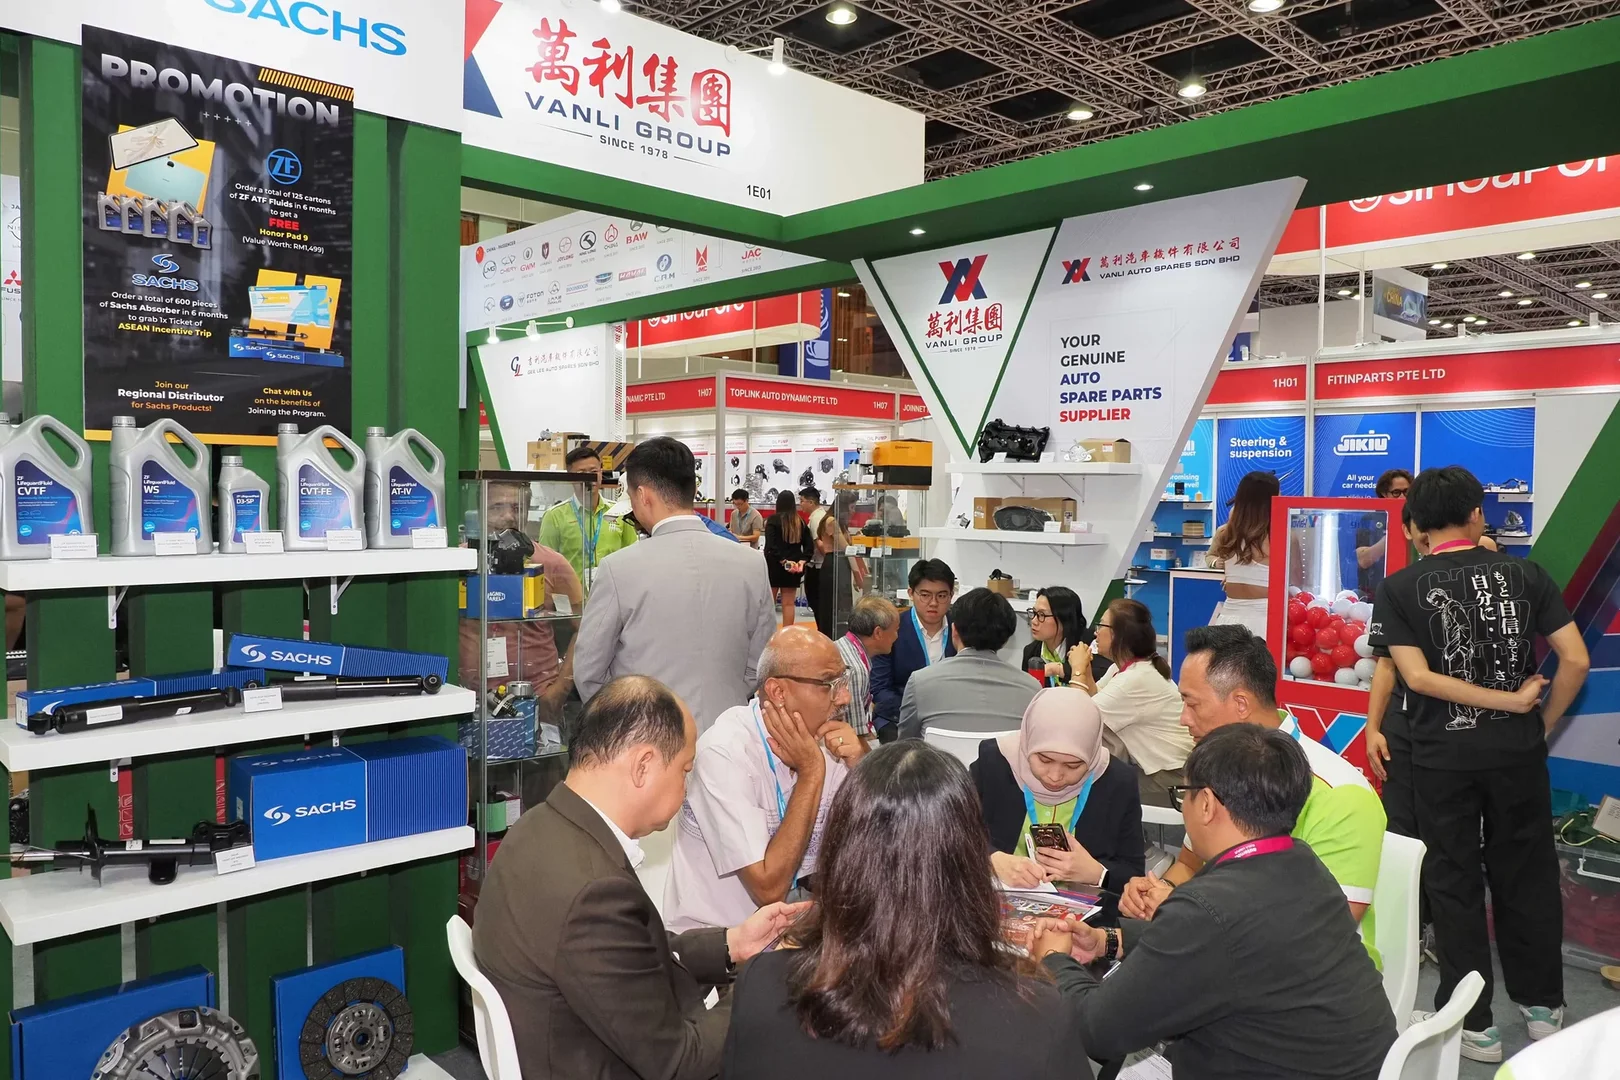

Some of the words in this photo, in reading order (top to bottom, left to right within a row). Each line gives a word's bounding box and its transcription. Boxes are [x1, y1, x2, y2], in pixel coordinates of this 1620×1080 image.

[526, 17, 731, 137] 萬利集團
[101, 54, 339, 126] PROMOTION
[525, 92, 620, 131] VANLI
[636, 121, 731, 157] GROUP
[600, 134, 635, 152] SINCE
[640, 145, 668, 160] 1978
[235, 183, 256, 192] Order
[264, 188, 281, 197] total
[304, 195, 331, 205] cartons
[746, 184, 772, 200] 1E01
[269, 198, 293, 208] Fluids
[309, 205, 336, 215] months
[269, 217, 299, 230] FREE
[260, 228, 285, 238] Honor
[286, 231, 301, 240] Pad
[626, 231, 648, 244] BAW
[242, 236, 266, 246] (Value
[267, 239, 292, 249] Worth:
[293, 243, 325, 255] RM1,499)
[741, 248, 762, 260] JAC
[520, 263, 536, 272] GWM
[1100, 269, 1125, 279] VANLI
[1128, 267, 1151, 276] AUTO
[1154, 262, 1192, 272] SPARES
[1195, 258, 1216, 267] SDN
[1219, 255, 1240, 264] BHD
[132, 273, 198, 292] SACHS
[112, 291, 136, 300] Order
[144, 295, 163, 303] total
[110, 301, 137, 311] Sachs
[139, 305, 180, 315] Absorber
[198, 310, 228, 319] months
[138, 315, 158, 324] grab
[169, 318, 193, 326] Ticket
[926, 302, 1002, 338] 萬利集團
[118, 323, 150, 332] ASEAN
[152, 325, 193, 336] Incentive
[195, 329, 212, 338] Trip
[926, 339, 957, 348] VANLI
[963, 334, 1002, 344] GROUP
[1060, 334, 1101, 349] YOUR
[1060, 351, 1126, 367] GENUINE
[1060, 372, 1101, 386] AUTO
[1272, 377, 1298, 388] 1H01
[1328, 371, 1395, 385] FITINPARTS
[1397, 370, 1420, 382] PTE
[1422, 368, 1446, 380] LTD
[155, 381, 172, 389] Join
[118, 388, 166, 399] Regional
[168, 391, 224, 402] Distributor
[655, 392, 665, 400] LTD
[698, 388, 712, 397] 1H07
[730, 388, 760, 398] TOPLINK
[761, 391, 780, 400] AUTO
[782, 393, 811, 403] DYNAMIC
[812, 396, 825, 404] PTE
[826, 396, 838, 405] LTD
[1060, 389, 1107, 404] SPARE
[1112, 387, 1162, 401] PARTS
[172, 403, 212, 412] Products!
[280, 398, 311, 407] benefits
[873, 401, 888, 409] 1H07
[248, 407, 276, 416] Joining
[292, 409, 326, 418] Program.
[1060, 408, 1131, 422] SUPPLIER
[1230, 436, 1275, 447] Steering
[1279, 436, 1287, 446] &
[1230, 449, 1292, 459] suspension
[18, 487, 46, 495] CVTF
[144, 485, 160, 494] WS
[271, 650, 332, 666] SACHS
[282, 753, 342, 762] SACHS
[295, 799, 356, 817] SACHS
